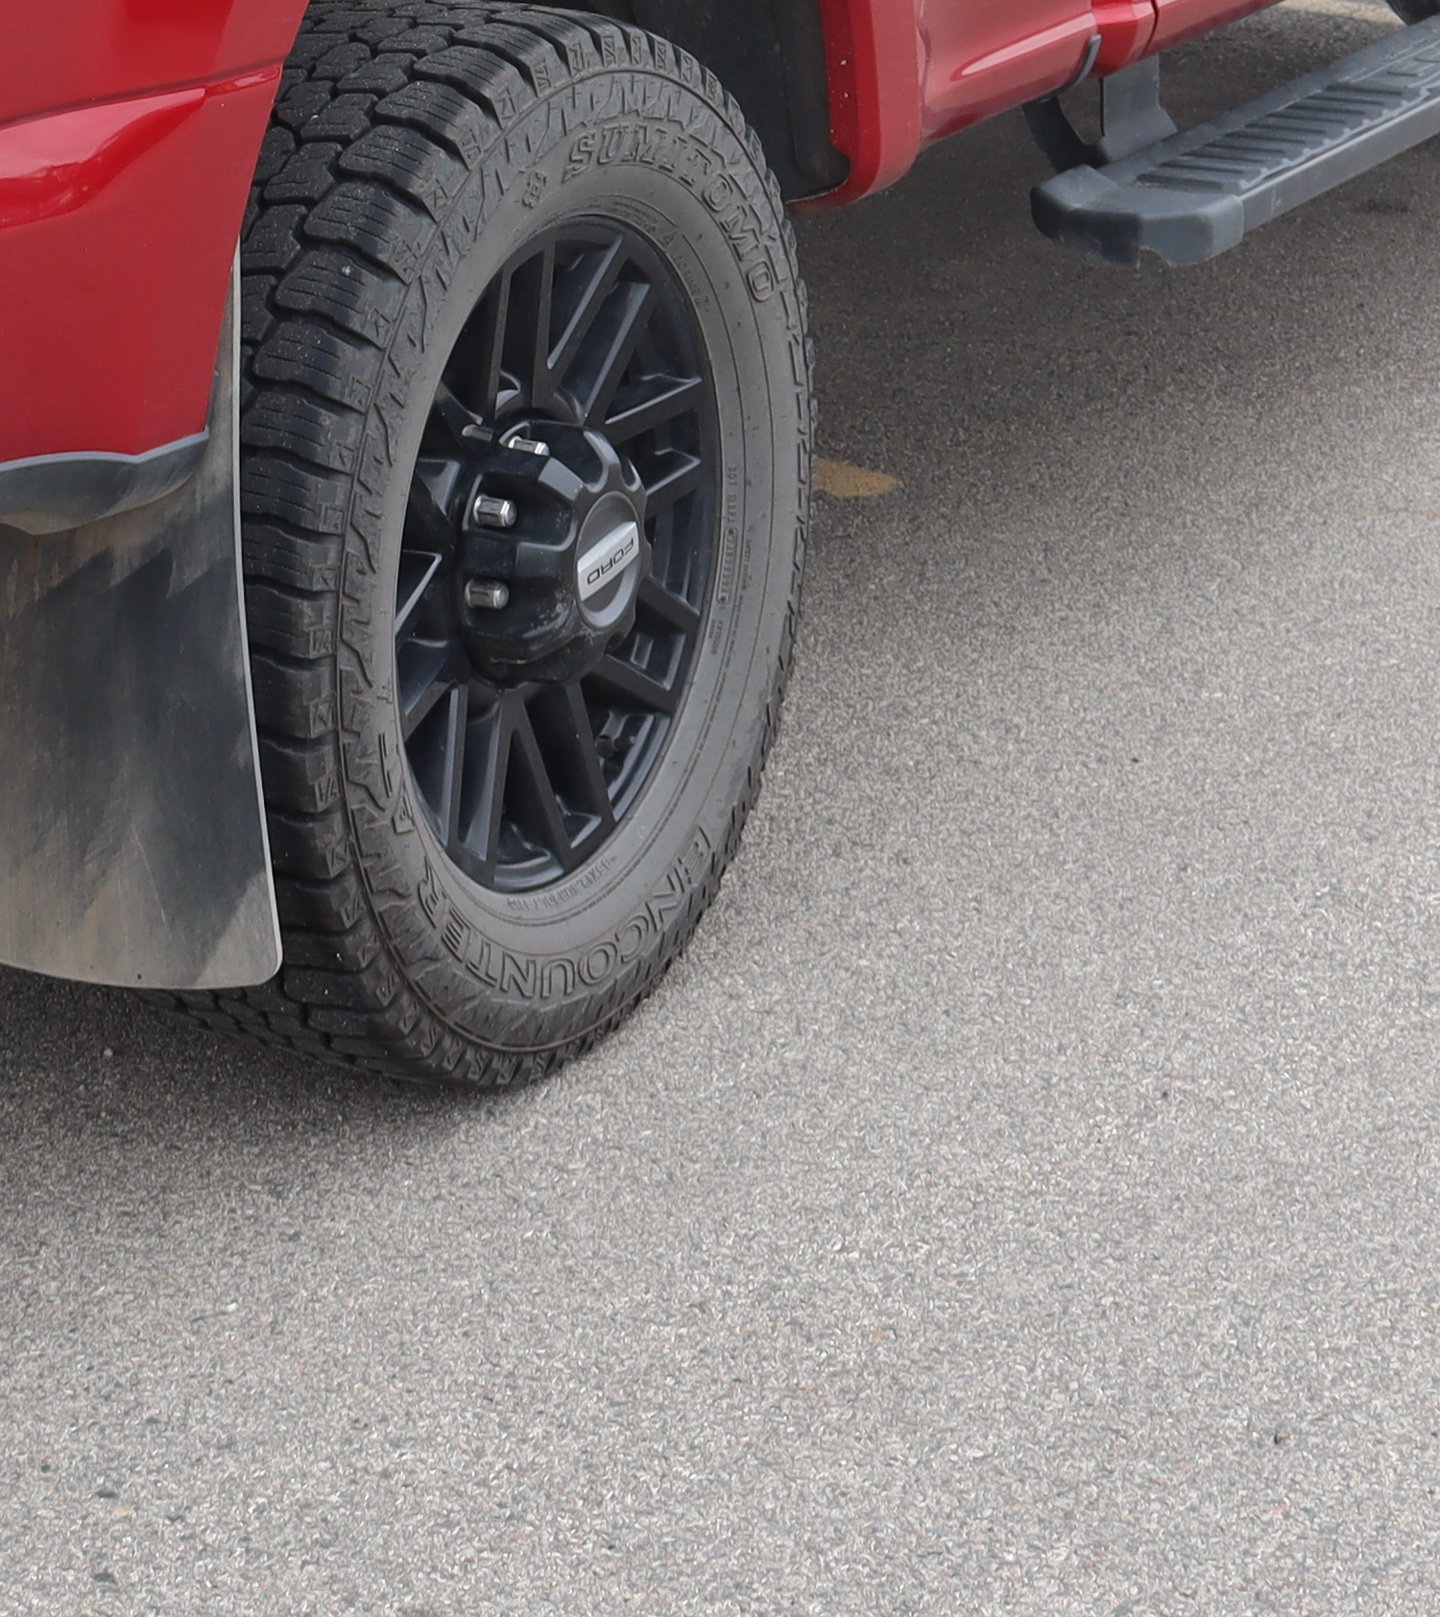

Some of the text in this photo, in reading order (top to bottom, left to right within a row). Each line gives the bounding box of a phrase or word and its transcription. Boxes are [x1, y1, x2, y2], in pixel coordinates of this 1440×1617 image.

[561, 123, 776, 304] SUMITOMO
[586, 537, 634, 585] FORD
[417, 826, 714, 1000] ENCOUNTER
